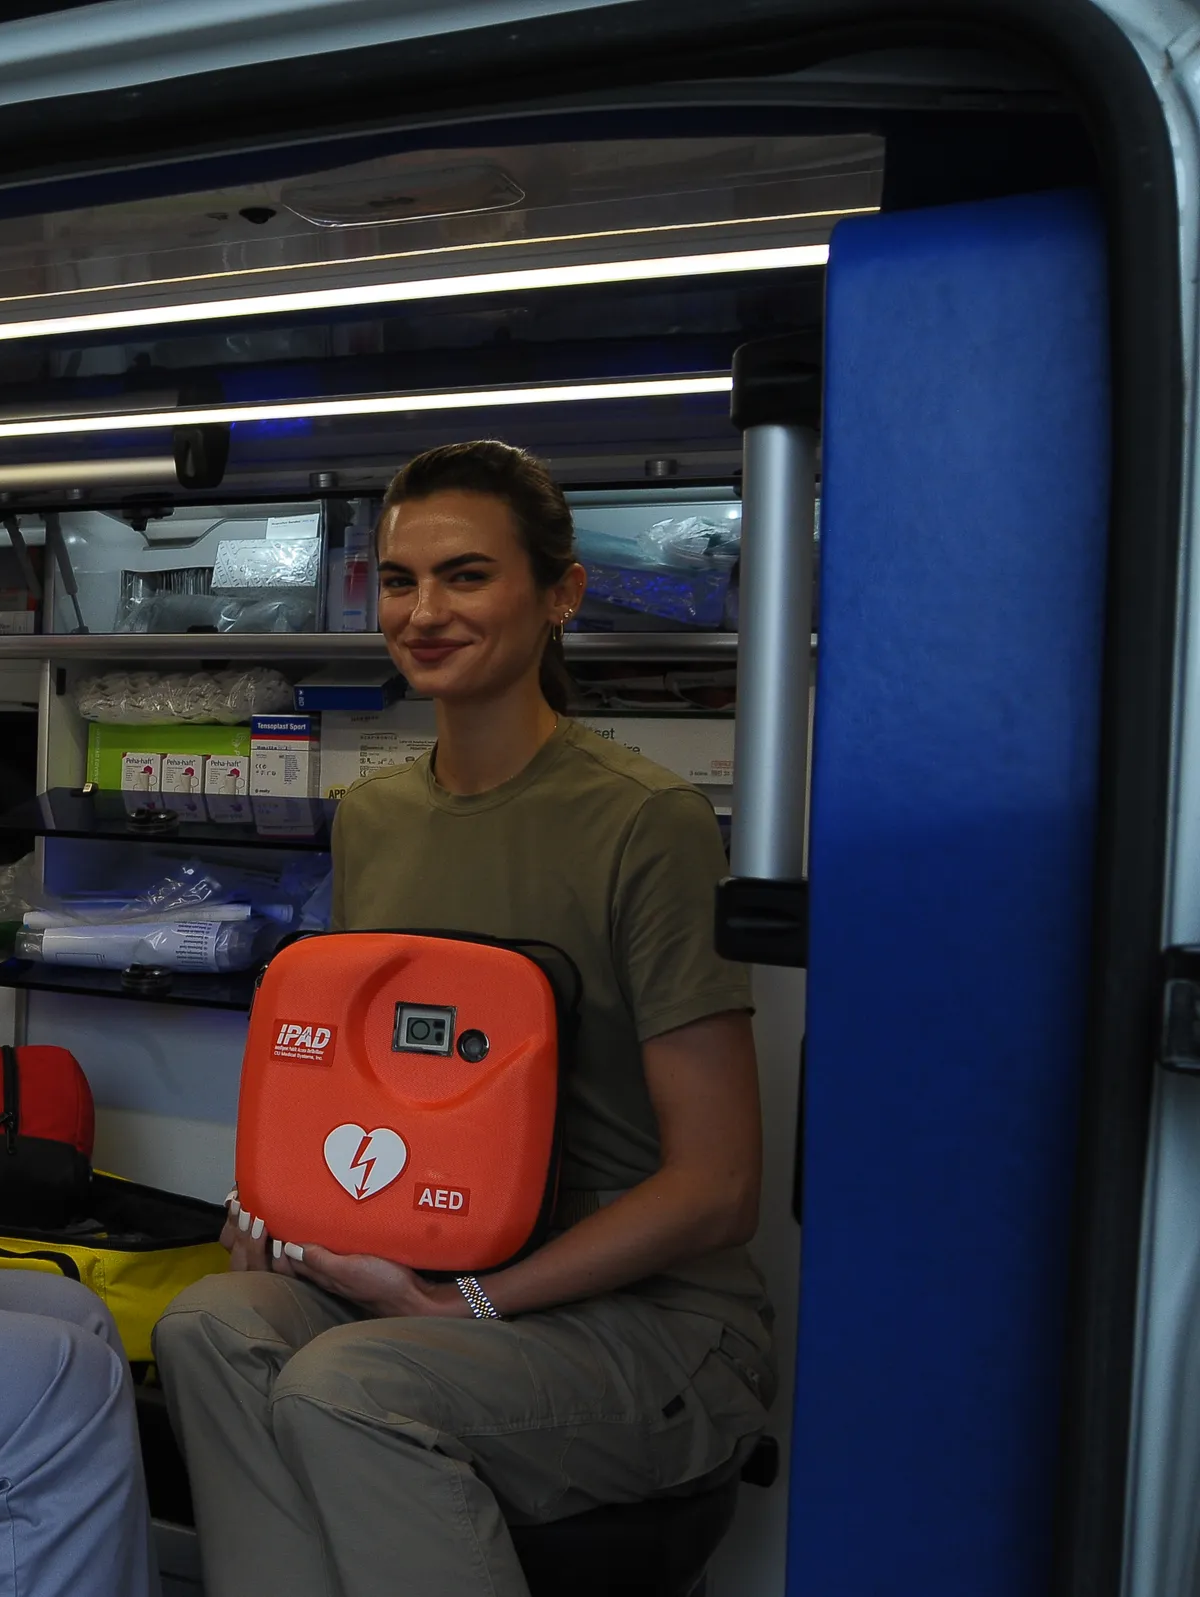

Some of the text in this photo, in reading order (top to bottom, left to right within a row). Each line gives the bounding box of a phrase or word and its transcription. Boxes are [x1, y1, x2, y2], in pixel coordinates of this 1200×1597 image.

[257, 722, 307, 731] Tensoplast Sport
[277, 1024, 331, 1048] IPAD
[417, 1187, 464, 1210] AED
